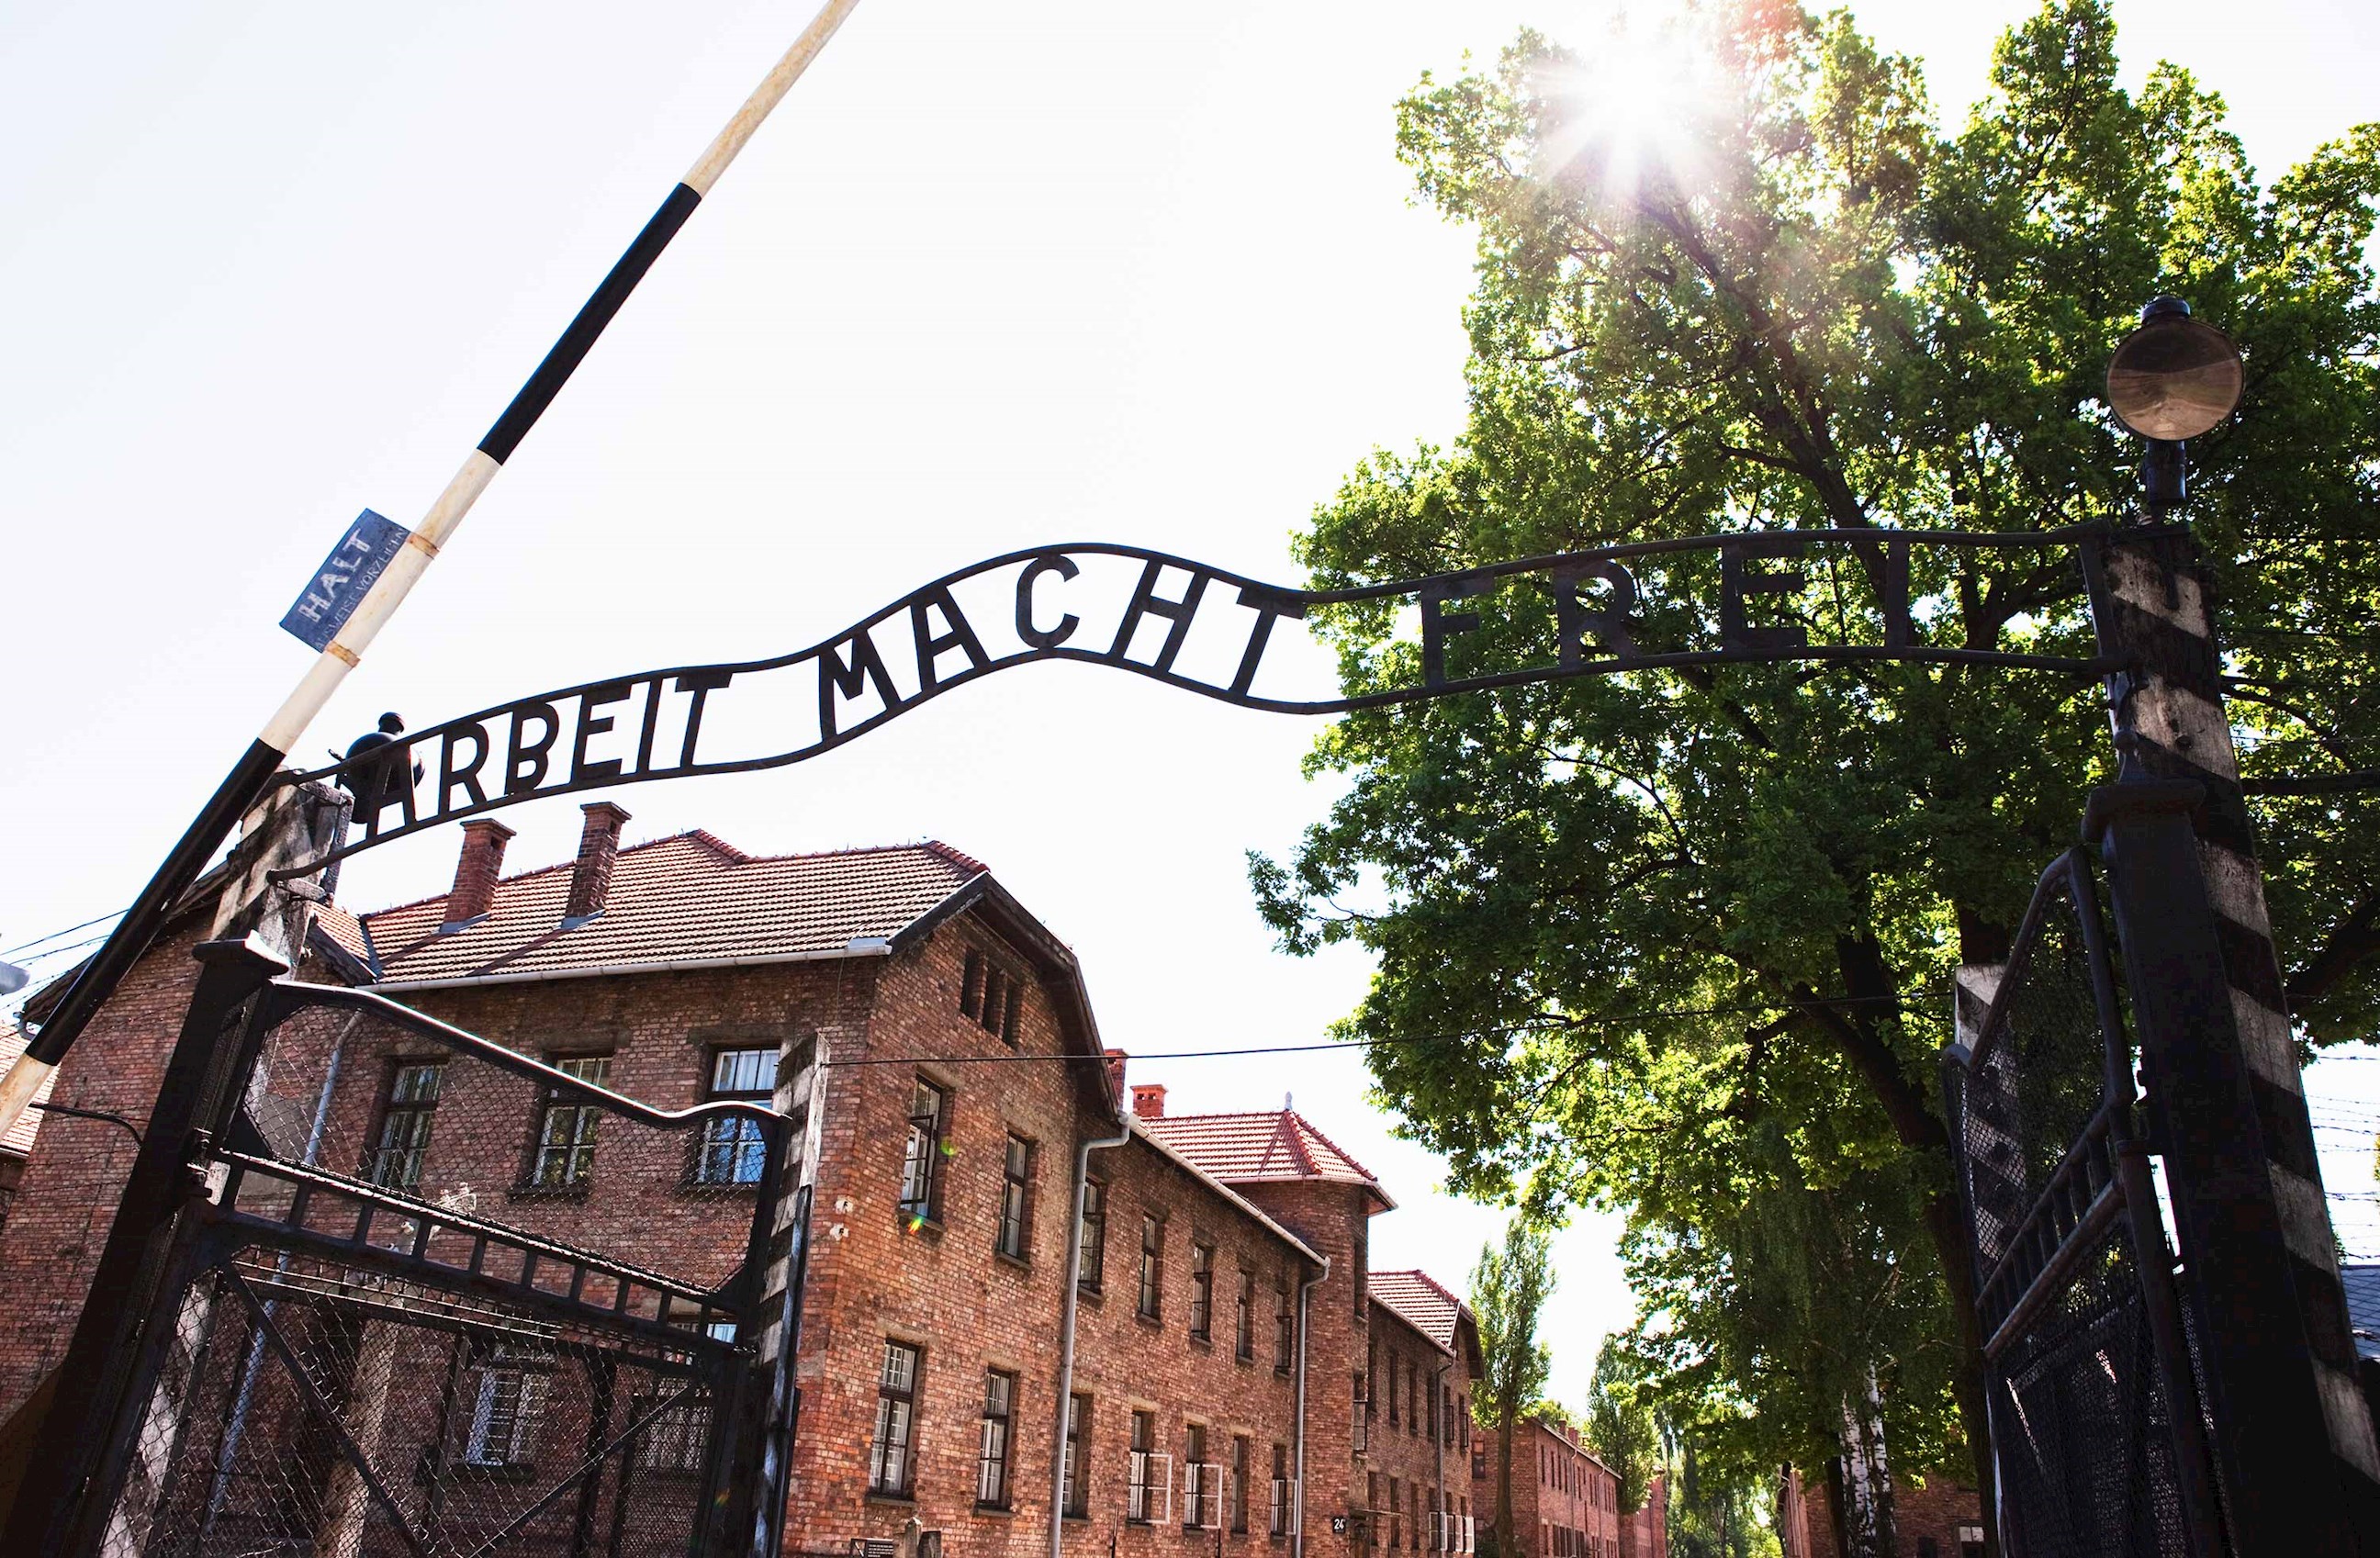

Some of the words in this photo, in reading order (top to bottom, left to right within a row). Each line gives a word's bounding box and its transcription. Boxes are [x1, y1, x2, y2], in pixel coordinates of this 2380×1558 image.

[298, 527, 371, 622] HALT
[366, 671, 734, 840] ARBEIT
[818, 553, 1308, 742] MACHT
[1420, 538, 1911, 688] FREI
[1334, 1518, 1346, 1530] 24
